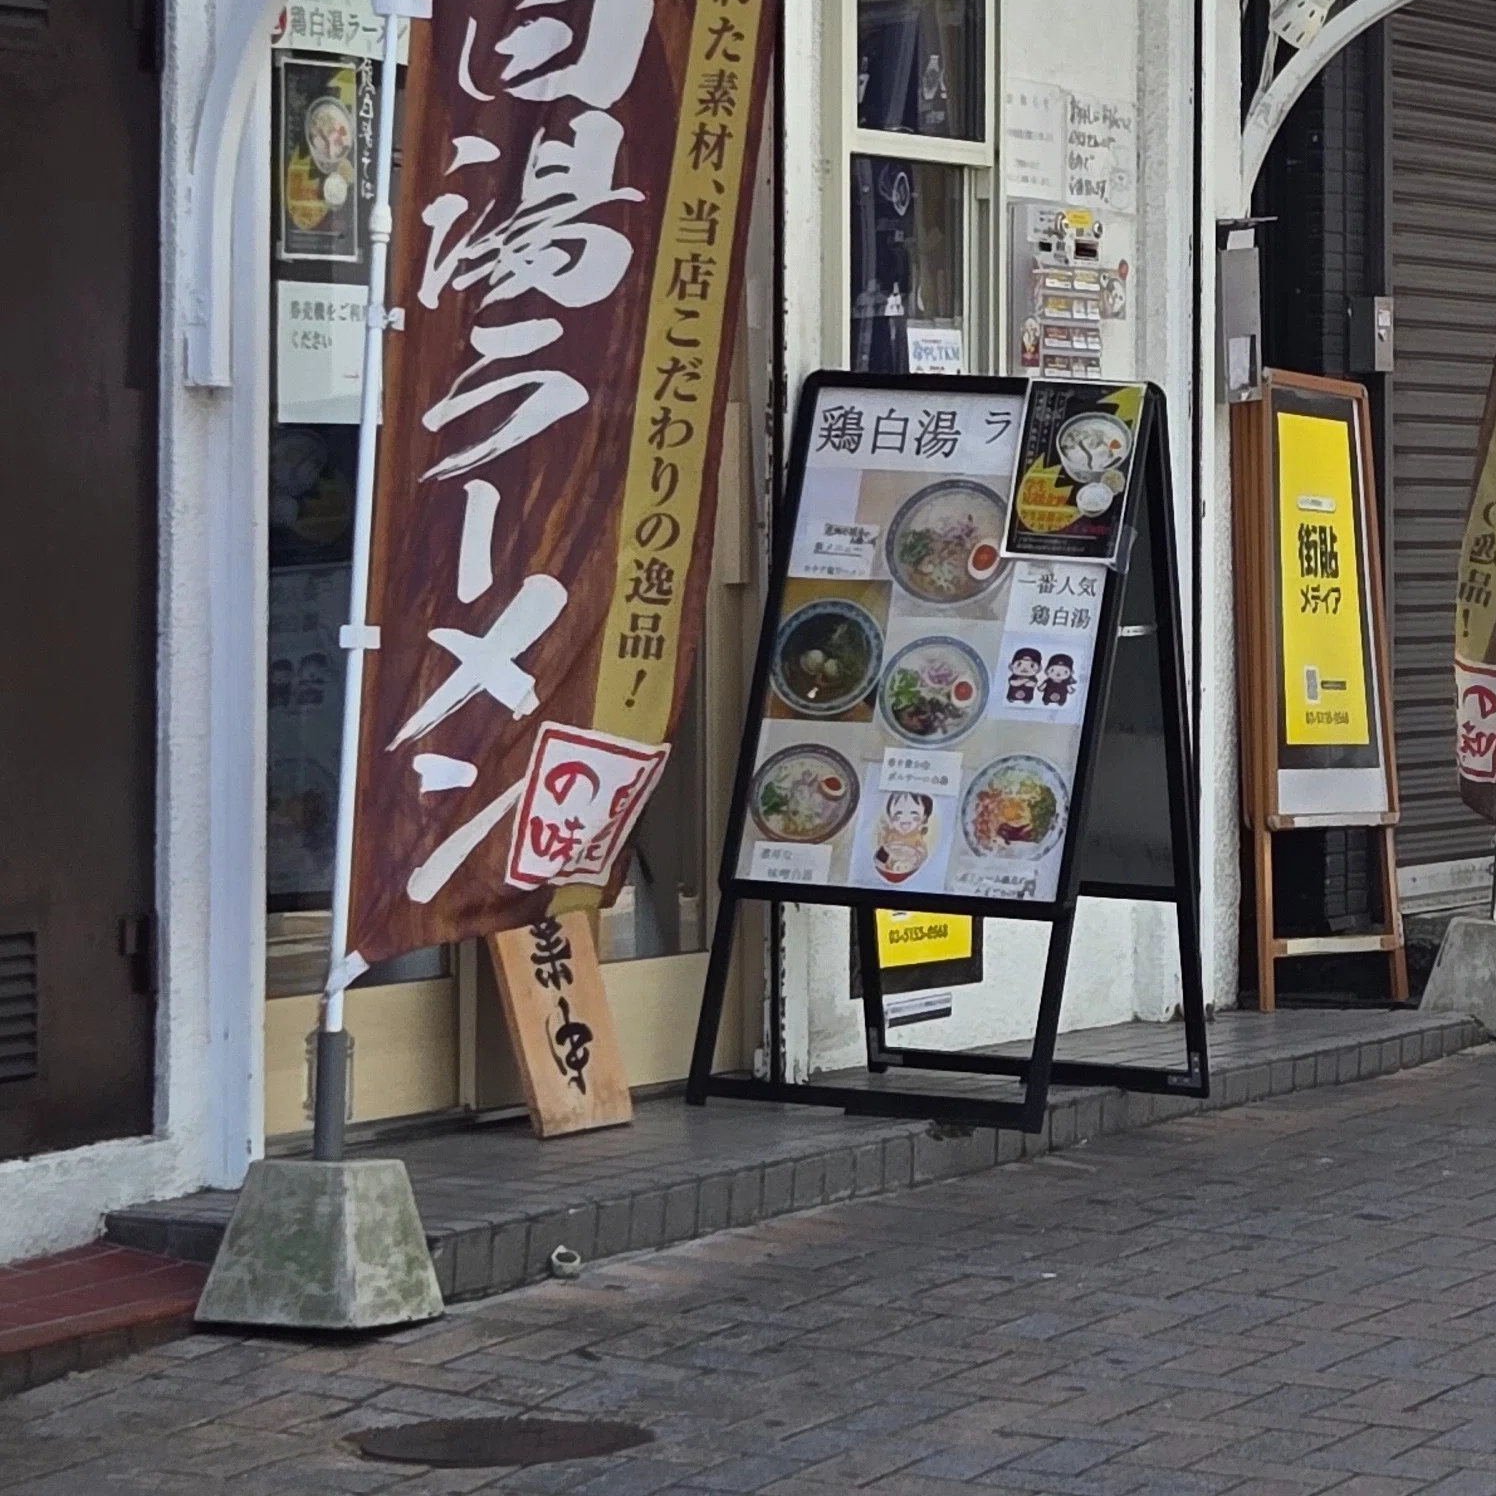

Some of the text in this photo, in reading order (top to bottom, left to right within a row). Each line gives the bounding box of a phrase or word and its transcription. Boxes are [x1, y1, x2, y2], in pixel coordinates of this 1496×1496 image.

[816, 404, 962, 460] 鶏白湯
[1298, 523, 1340, 578] 街貼
[1018, 573, 1098, 597] 一番人気
[1301, 583, 1341, 615] メディア
[1029, 605, 1092, 629] 鶏白湯
